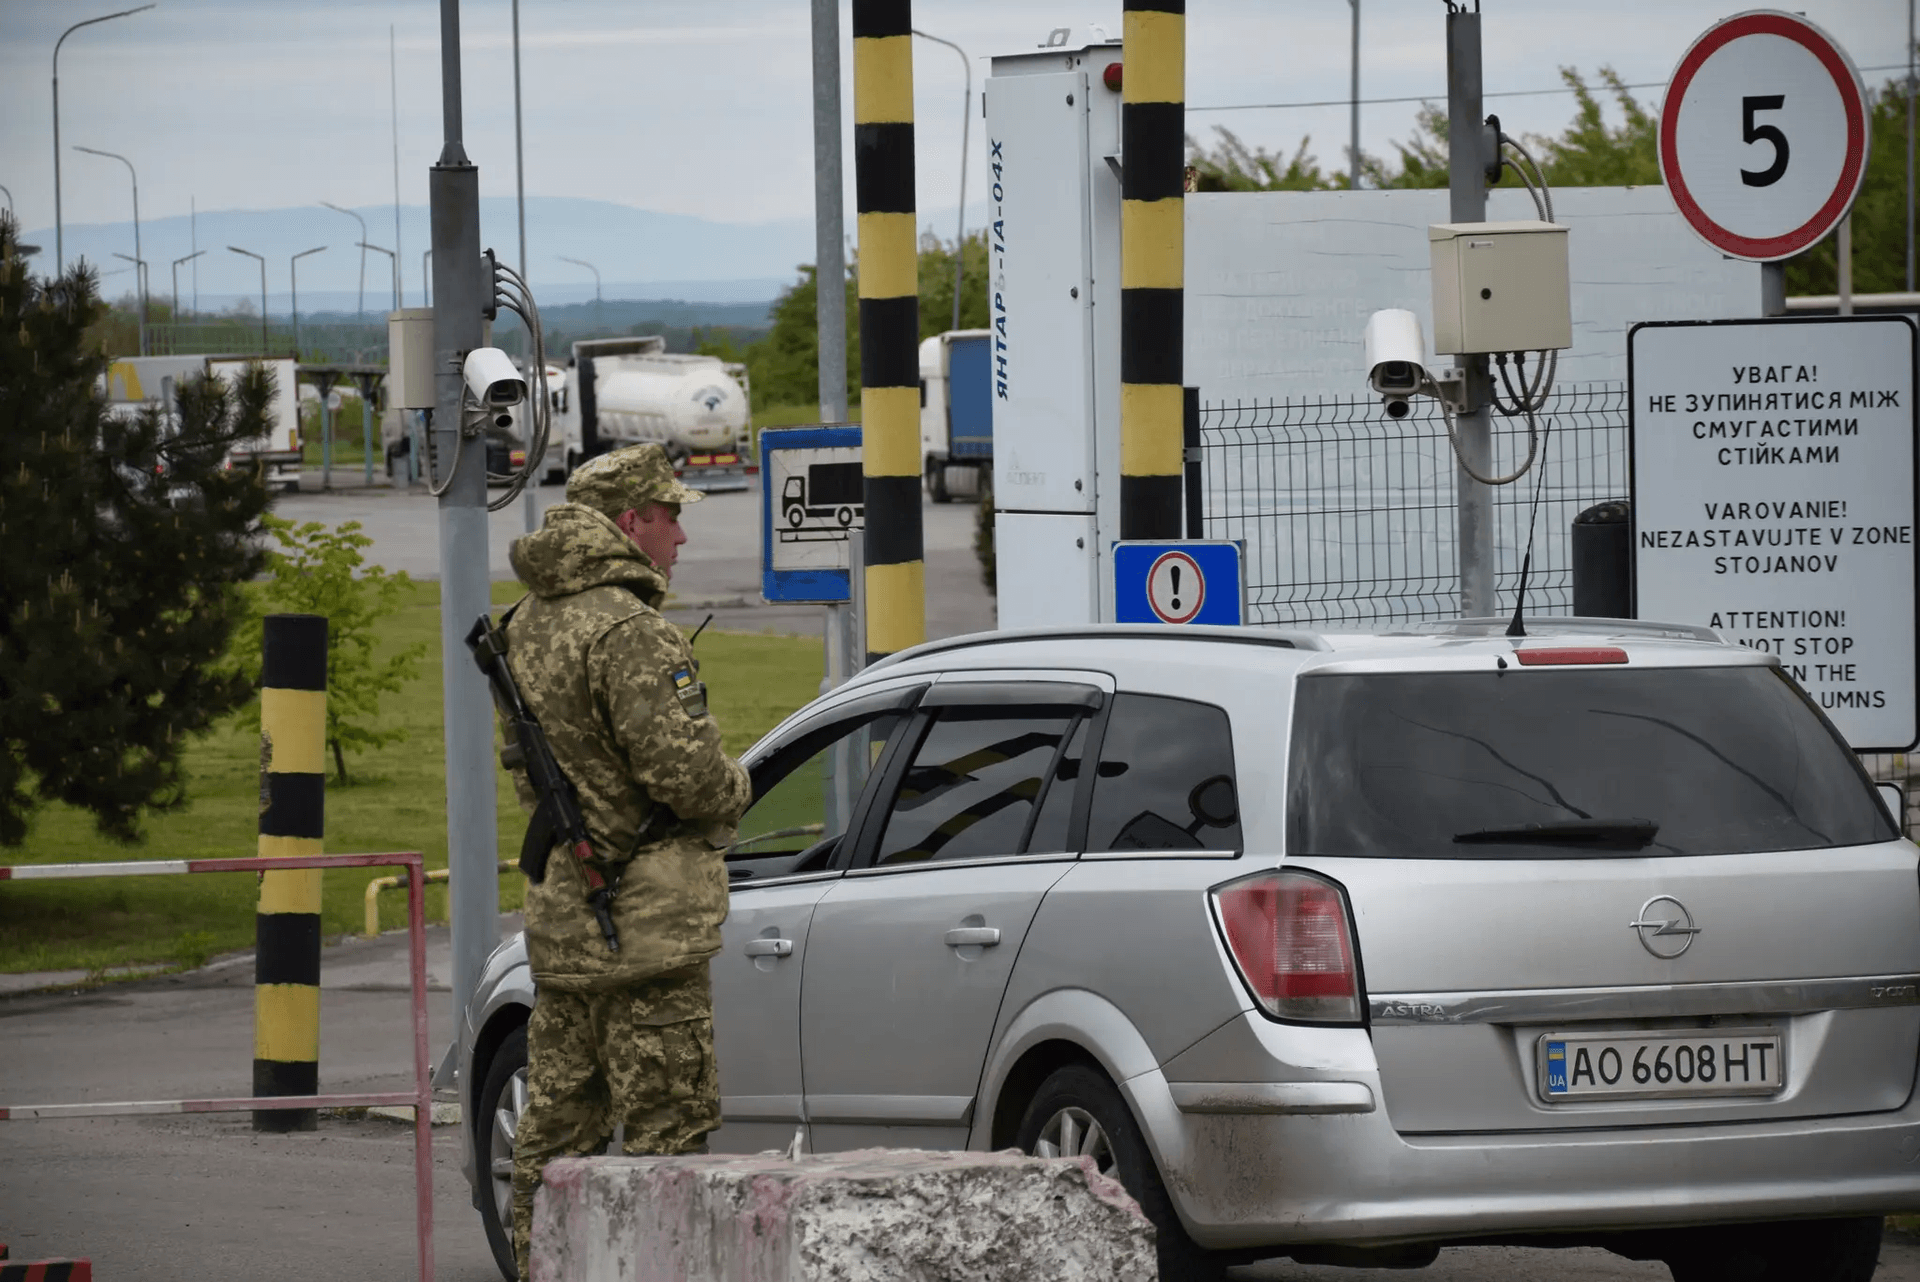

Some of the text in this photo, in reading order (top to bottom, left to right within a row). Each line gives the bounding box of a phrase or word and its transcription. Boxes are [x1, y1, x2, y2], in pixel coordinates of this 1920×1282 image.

[1740, 94, 1790, 188] 5
[1732, 365, 1818, 385] УВАГА!
[1649, 390, 1901, 413] НЕ ЗУПИНЯТИСЯ МІЖ
[1692, 418, 1859, 440] СМУГАСТИМИ
[1718, 442, 1840, 466] СТІЙКАМИ
[1704, 500, 1848, 521] VAROVANIE!
[1641, 525, 1912, 549] NEZASTAVUJTE V ZONE
[1714, 554, 1839, 575] STOJANOV
[1709, 610, 1846, 629] ATTENTION!
[1794, 637, 1854, 656] STOP
[1814, 663, 1857, 682] THE
[1808, 690, 1887, 709] UMNS
[1381, 1004, 1447, 1017] ASTRA
[1570, 1042, 1775, 1086] AO 6608 HT
[1549, 1074, 1566, 1088] UA
